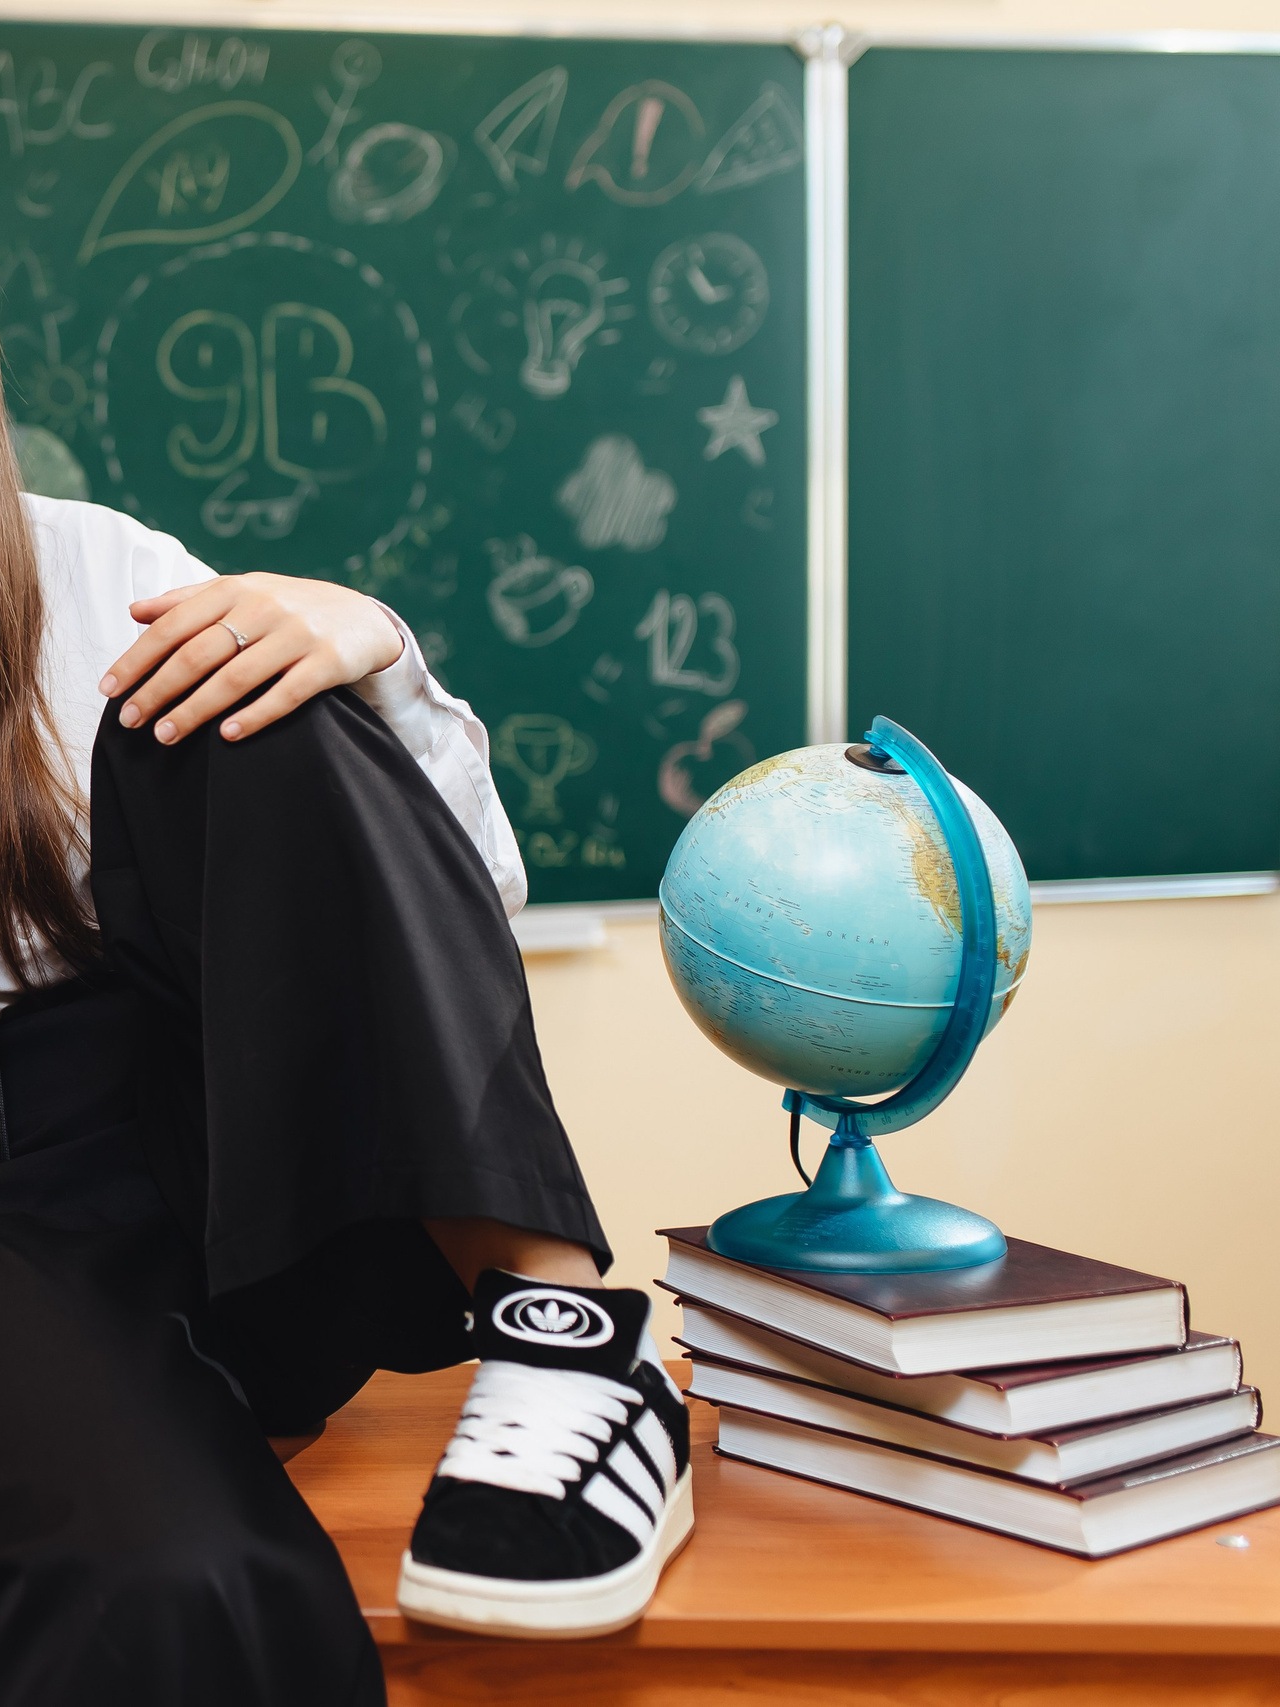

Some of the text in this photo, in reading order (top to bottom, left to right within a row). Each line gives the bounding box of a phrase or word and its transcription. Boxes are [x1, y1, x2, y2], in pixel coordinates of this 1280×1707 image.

[634, 588, 741, 696] 123
[725, 891, 774, 919] ТИХИЙ
[826, 930, 890, 947] ОКЕАН
